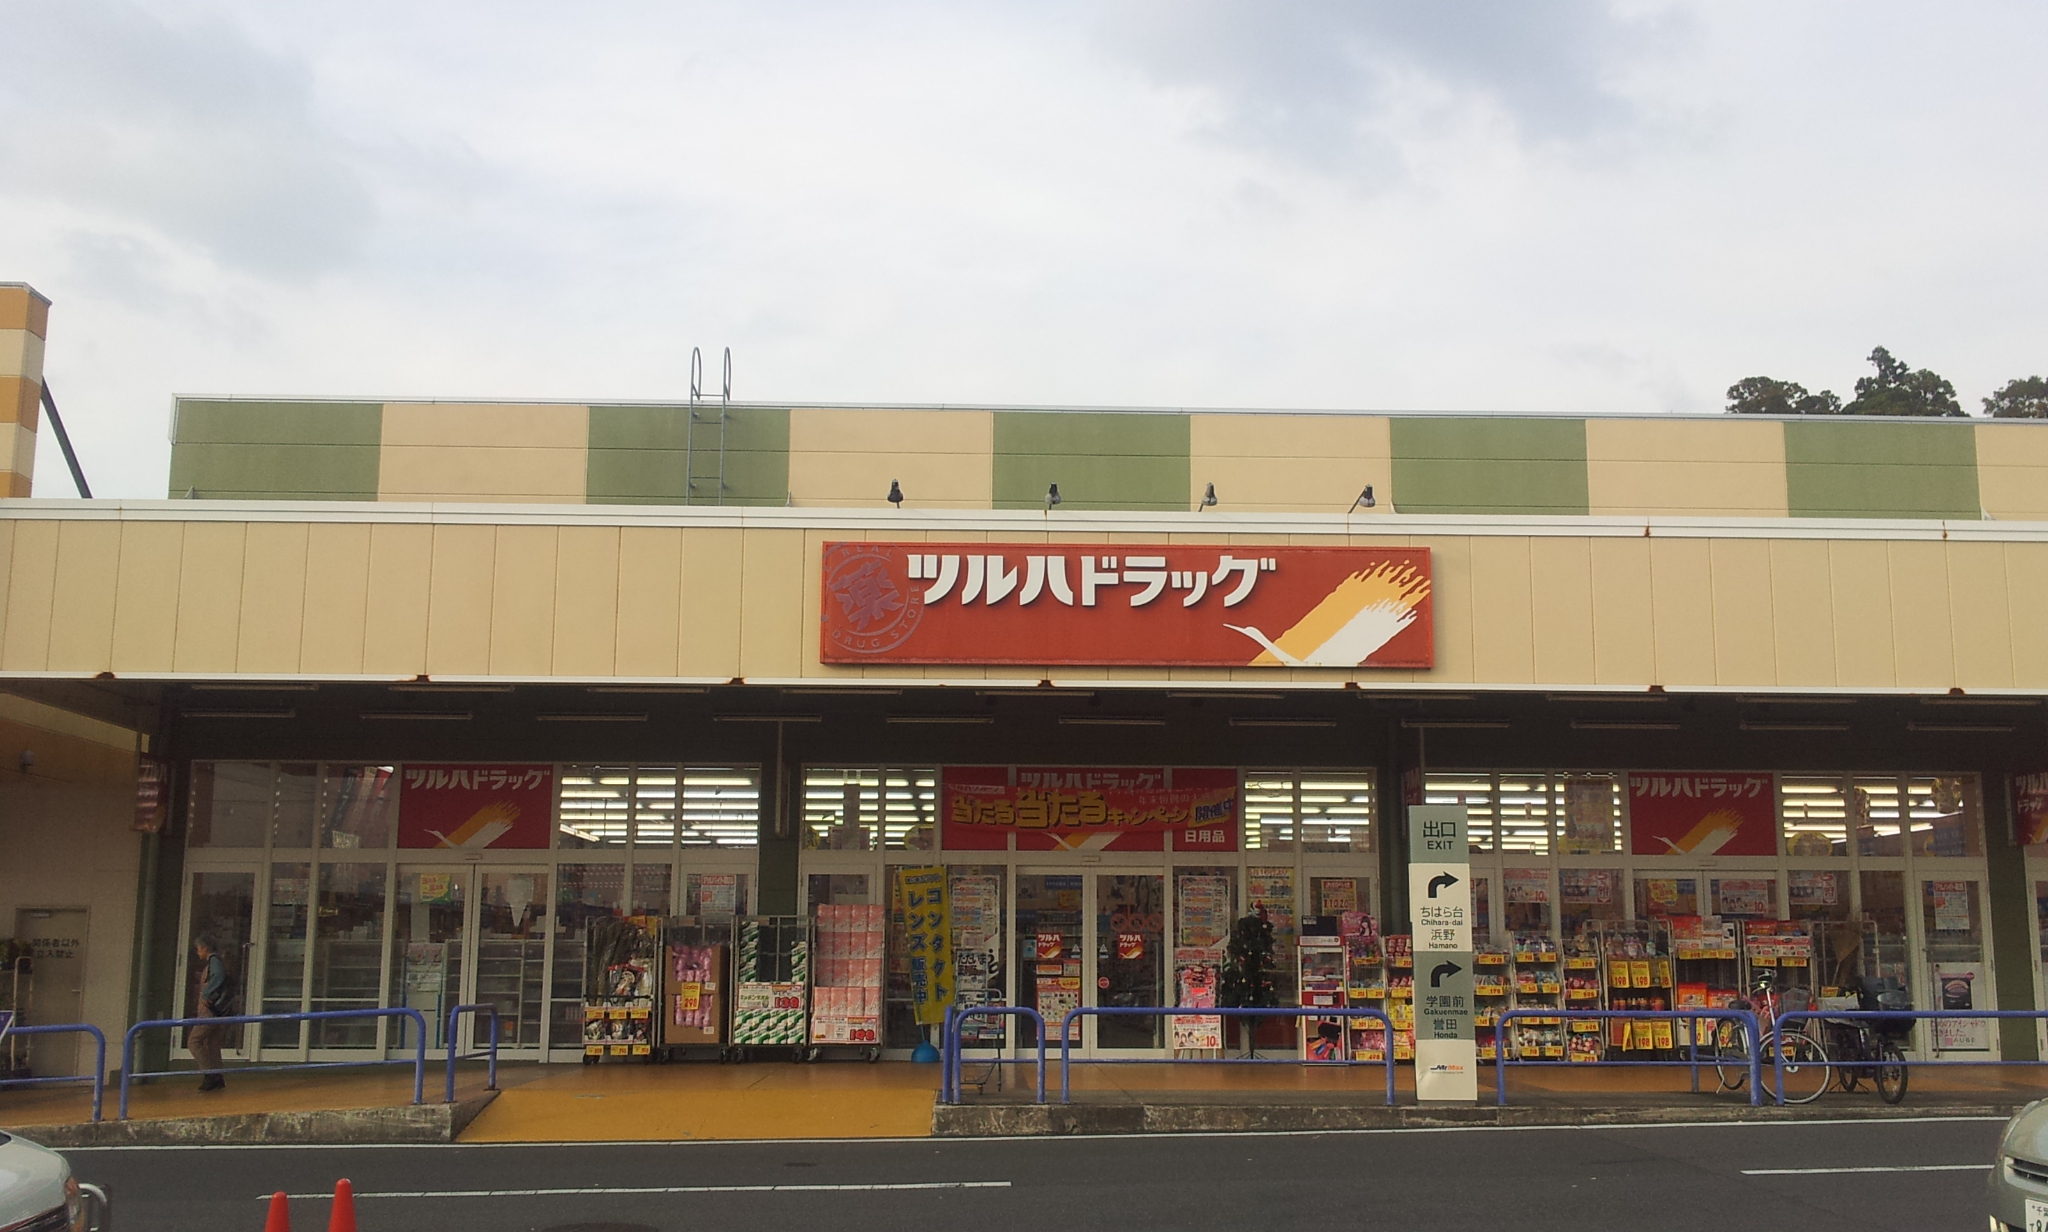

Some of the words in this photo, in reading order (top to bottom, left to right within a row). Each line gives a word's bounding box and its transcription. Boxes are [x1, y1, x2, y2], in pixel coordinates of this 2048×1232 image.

[907, 554, 1277, 607] ツルハドラッグ
[831, 629, 881, 648] DRUG
[890, 585, 920, 640] STORE
[405, 768, 550, 791] ツルハドラッグ
[1020, 772, 1162, 790] ツルハドラッグ
[1629, 777, 1768, 799] ツルハドラッグ
[1195, 797, 1235, 822] 開催中
[1422, 820, 1456, 838] 出口
[1184, 830, 1226, 843] 日用品
[1427, 840, 1454, 850] EXIT
[1420, 906, 1463, 918] ちはら台
[1038, 934, 1060, 942] ツルハ
[1119, 934, 1142, 942] ツルハ
[1430, 929, 1455, 941] 浜野
[908, 890, 929, 1004] レンズ販売中
[926, 887, 948, 1002] コンタクト
[36, 949, 74, 958] 立入禁止
[1614, 976, 1627, 985] 198
[1636, 976, 1648, 985] 198
[1426, 996, 1464, 1008] 学園前
[1434, 1031, 1458, 1039] Honda
[1638, 1037, 1650, 1046] 198
[1657, 1037, 1670, 1046] 198
